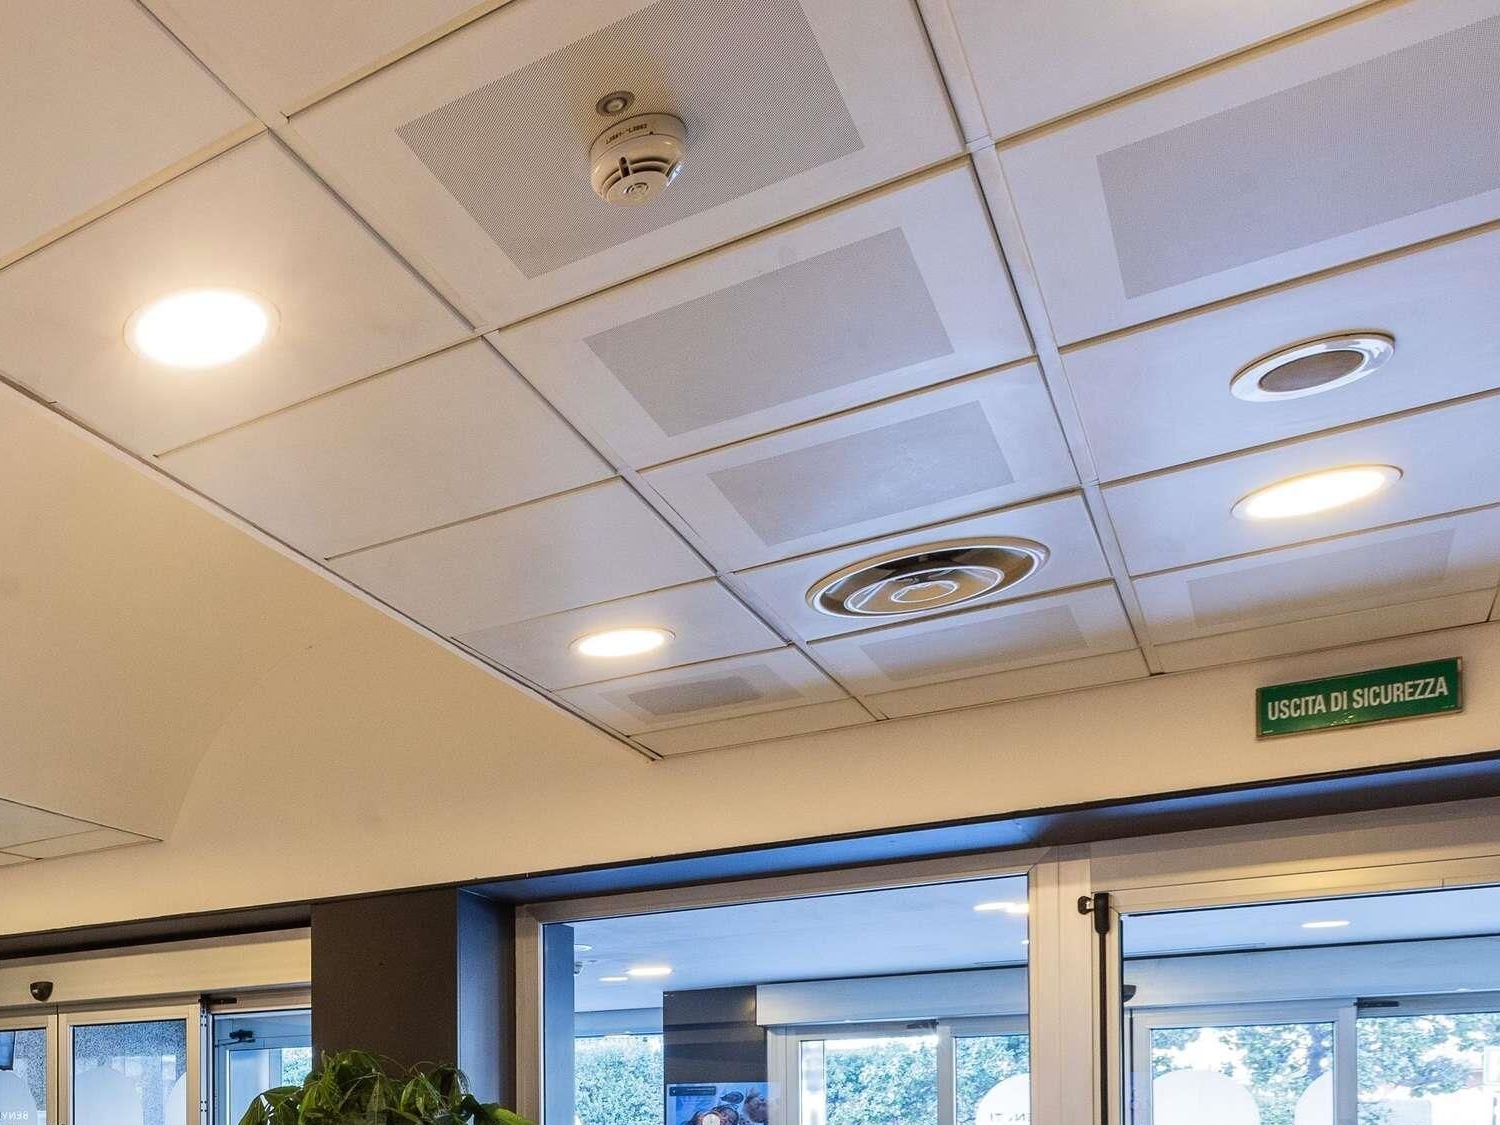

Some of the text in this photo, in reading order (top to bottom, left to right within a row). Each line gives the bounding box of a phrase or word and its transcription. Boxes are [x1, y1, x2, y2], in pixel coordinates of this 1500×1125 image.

[1267, 676, 1449, 721] USCITA DI SICUREZZA
